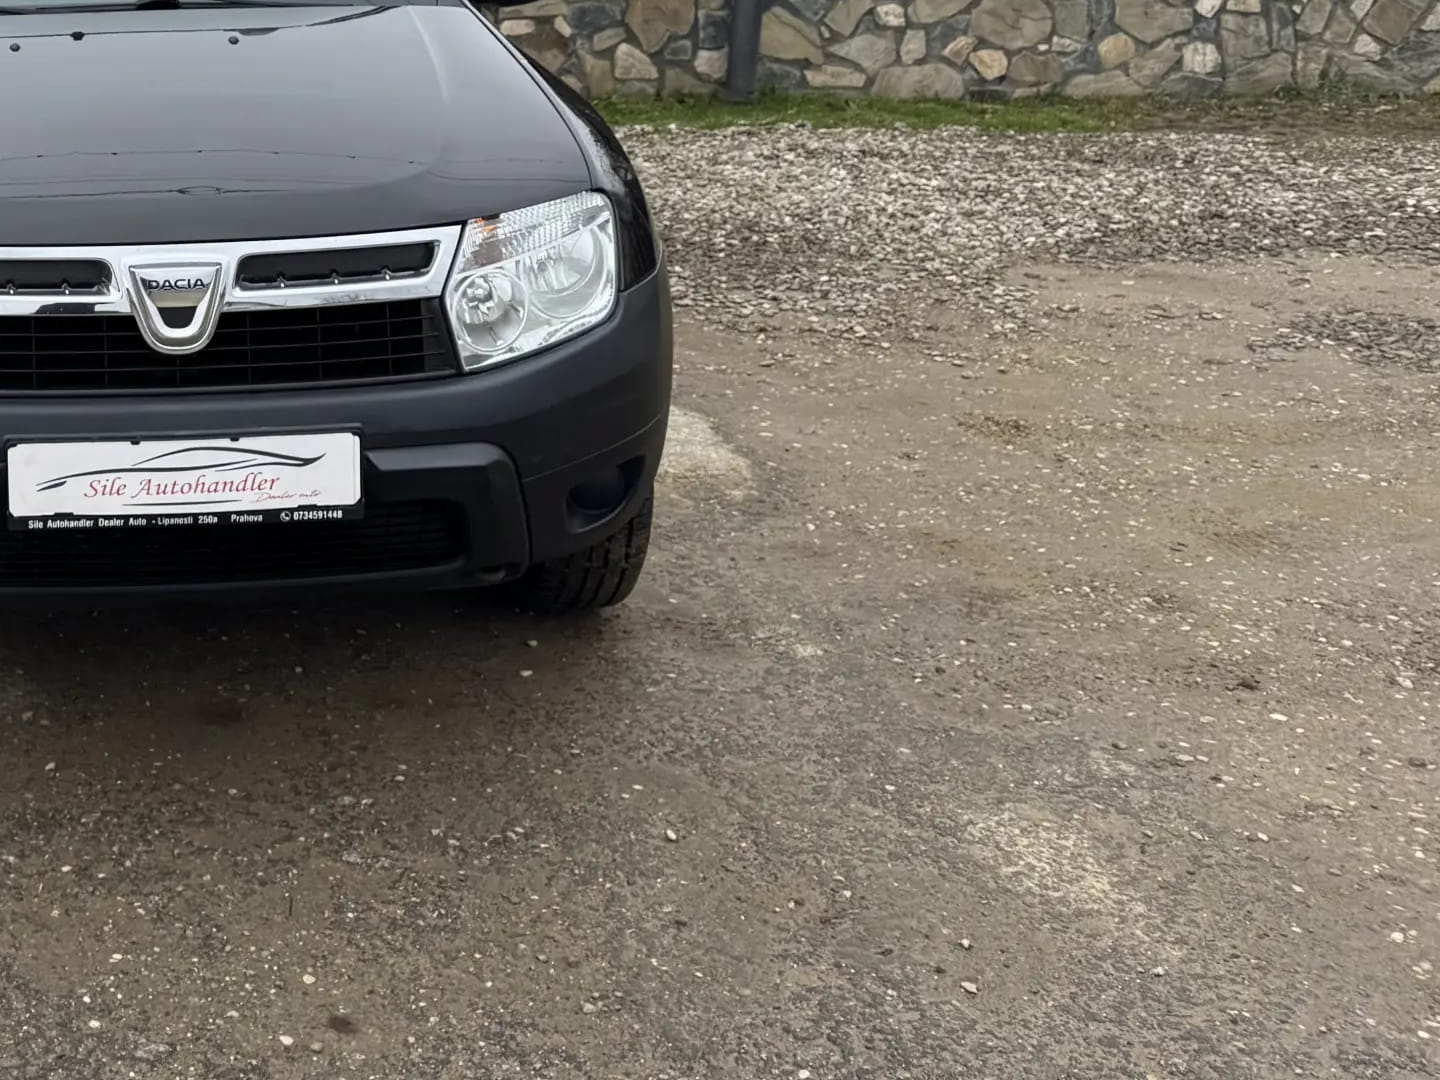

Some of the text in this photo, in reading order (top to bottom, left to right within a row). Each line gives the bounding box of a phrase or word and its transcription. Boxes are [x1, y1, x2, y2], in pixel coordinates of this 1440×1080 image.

[147, 278, 206, 290] DACIA
[84, 472, 280, 499] Sile Autohandler
[28, 520, 44, 529] Sile
[47, 518, 95, 528] Autohandler
[98, 518, 124, 527] Dealer
[128, 517, 147, 526] Auto
[198, 515, 218, 524] 250a
[231, 514, 263, 523] Prahova
